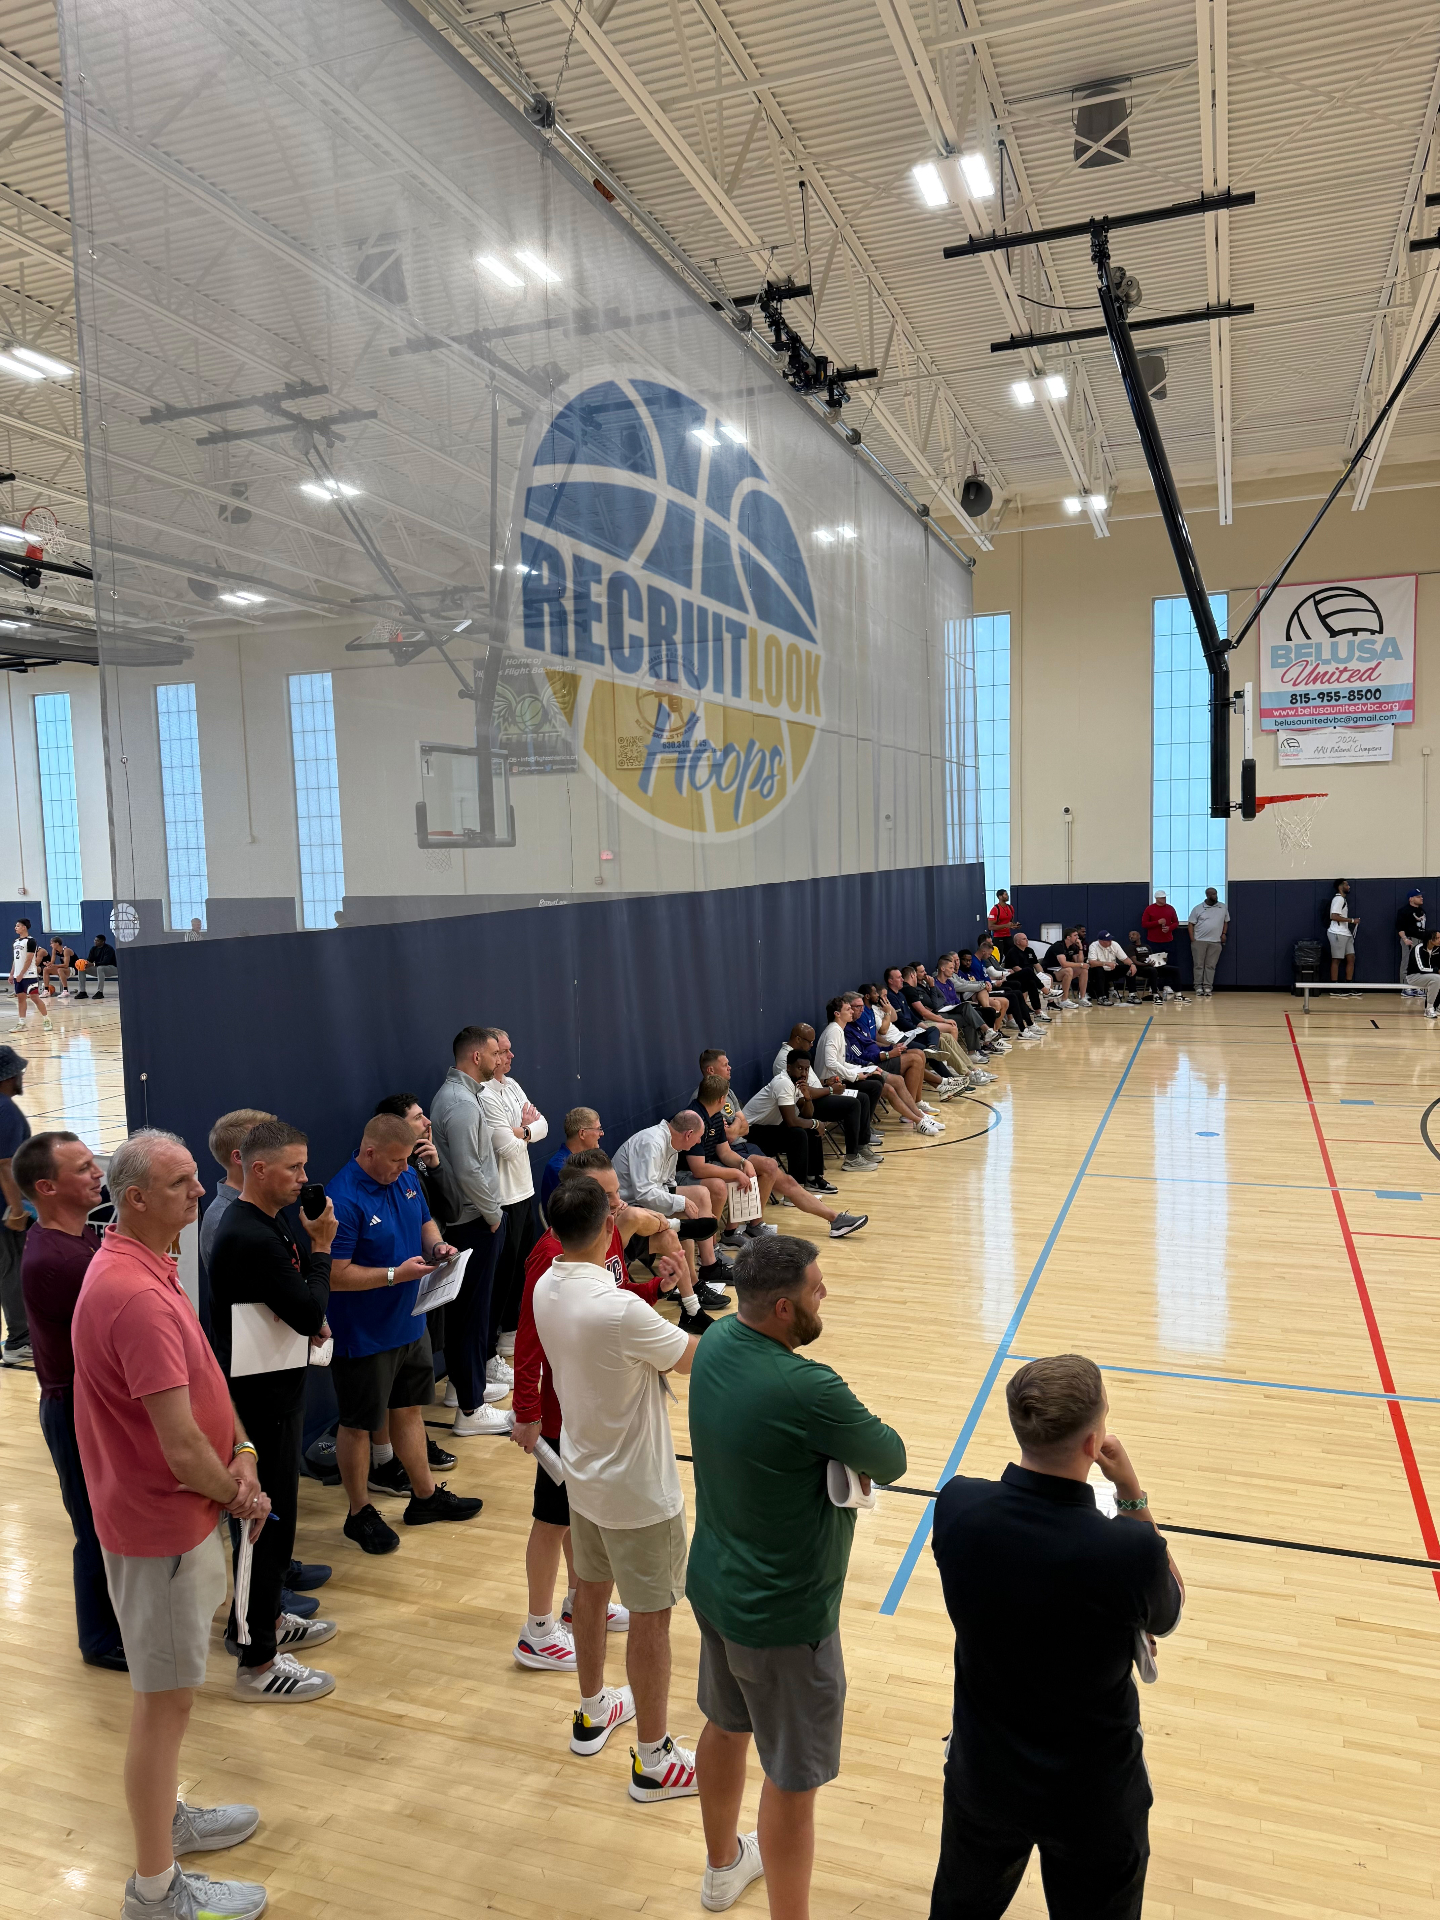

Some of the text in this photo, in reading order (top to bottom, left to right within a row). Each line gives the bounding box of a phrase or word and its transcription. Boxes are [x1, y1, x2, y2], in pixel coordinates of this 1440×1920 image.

[1270, 636, 1403, 669] BELUSA
[505, 657, 542, 666] Home of
[504, 667, 529, 676] Flight
[1280, 659, 1383, 688] United
[1289, 687, 1382, 705] 815-955-8500
[1272, 702, 1399, 717] www.belusaunitedvbc.org
[1274, 713, 1398, 727] belusaunitedvbc@gmail.com
[637, 702, 784, 825] Hoops
